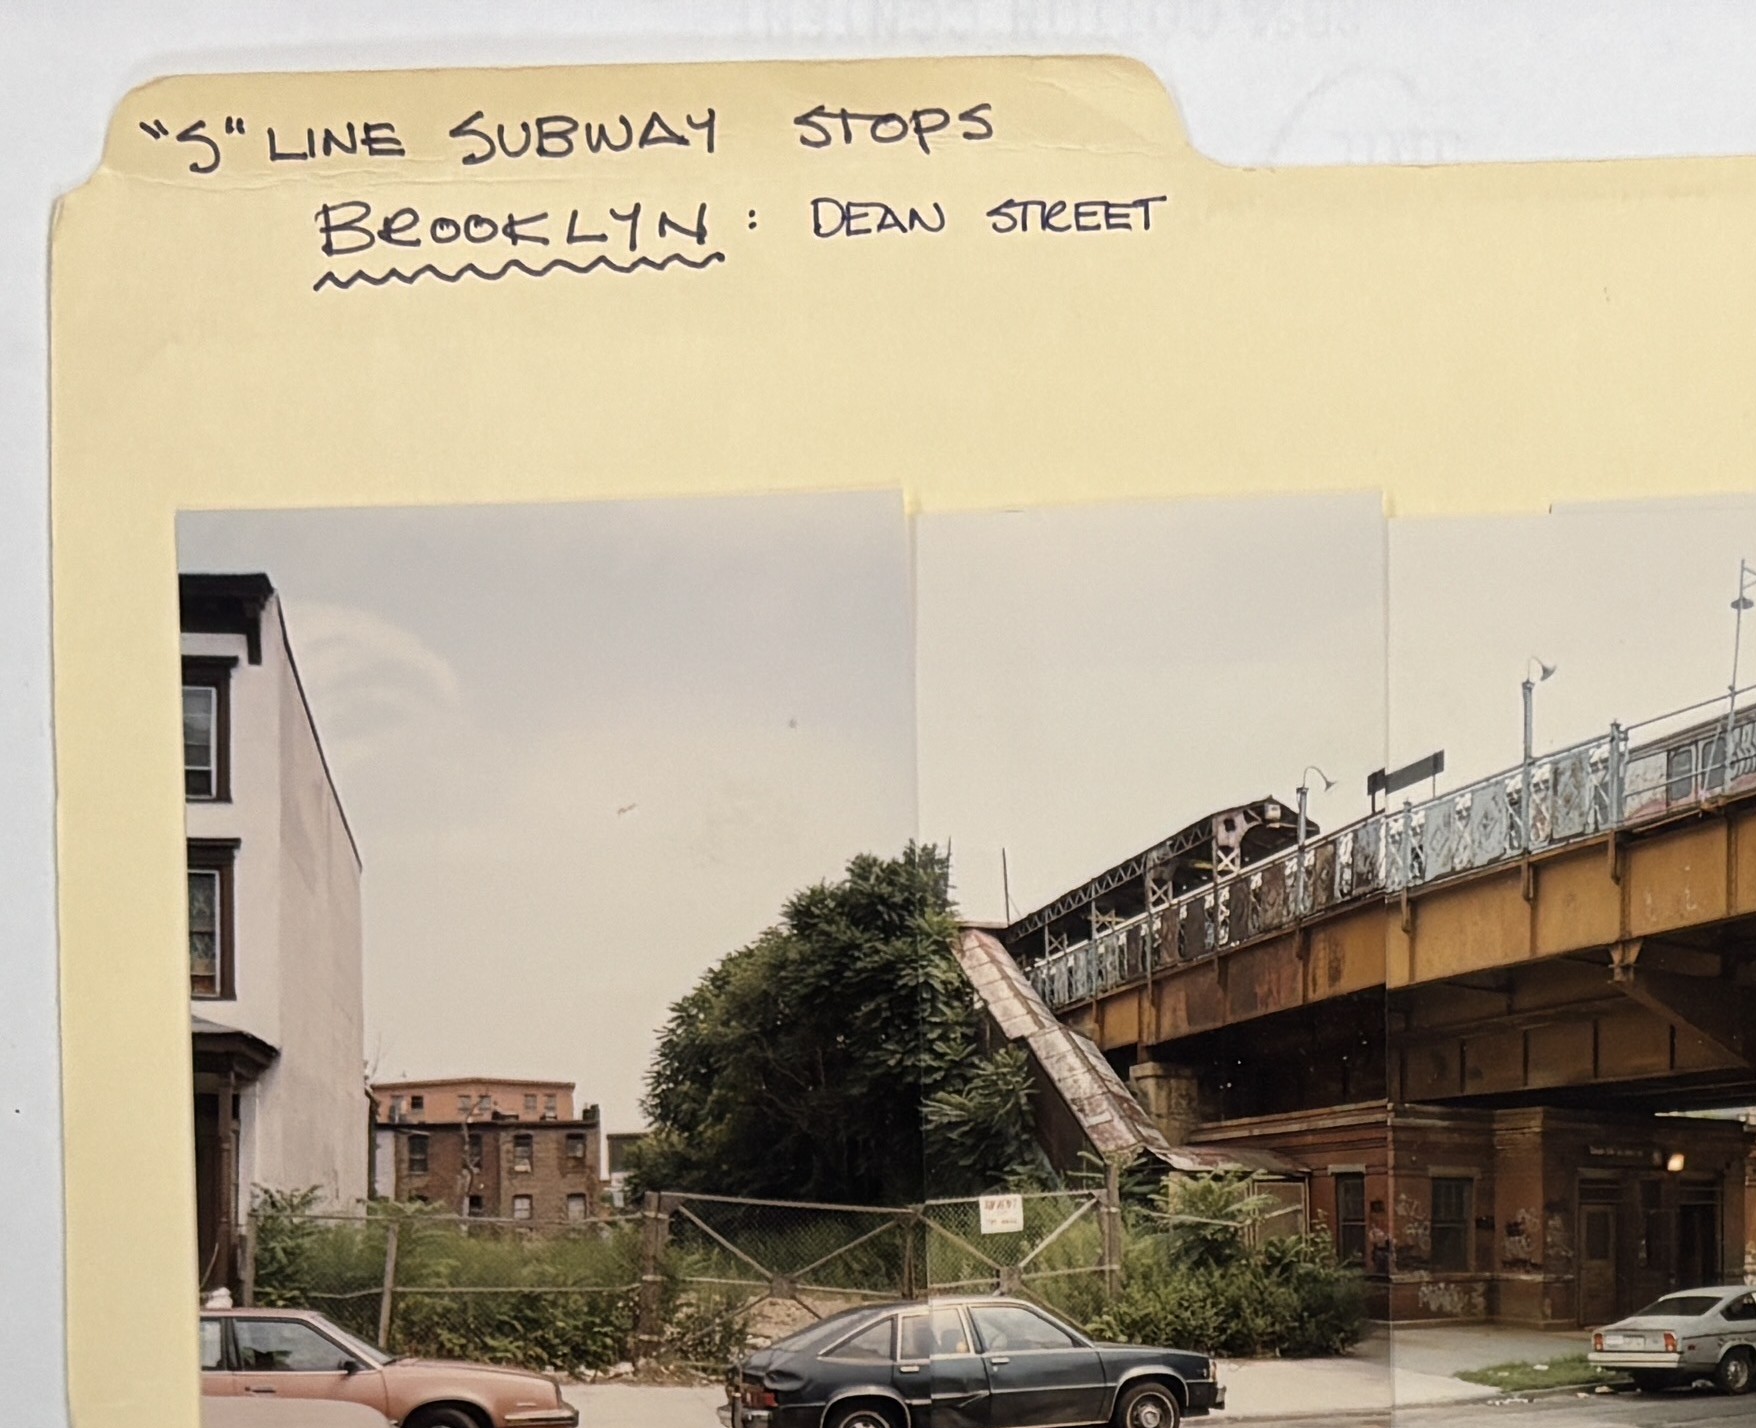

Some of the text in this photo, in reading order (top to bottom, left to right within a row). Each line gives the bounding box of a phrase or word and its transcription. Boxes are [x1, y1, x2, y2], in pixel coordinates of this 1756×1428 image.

[267, 121, 406, 162] LINE
[449, 108, 716, 165] SUBWAY
[793, 103, 993, 154] STOPS
[811, 197, 945, 238] DEAN
[986, 195, 1167, 233] STREET
